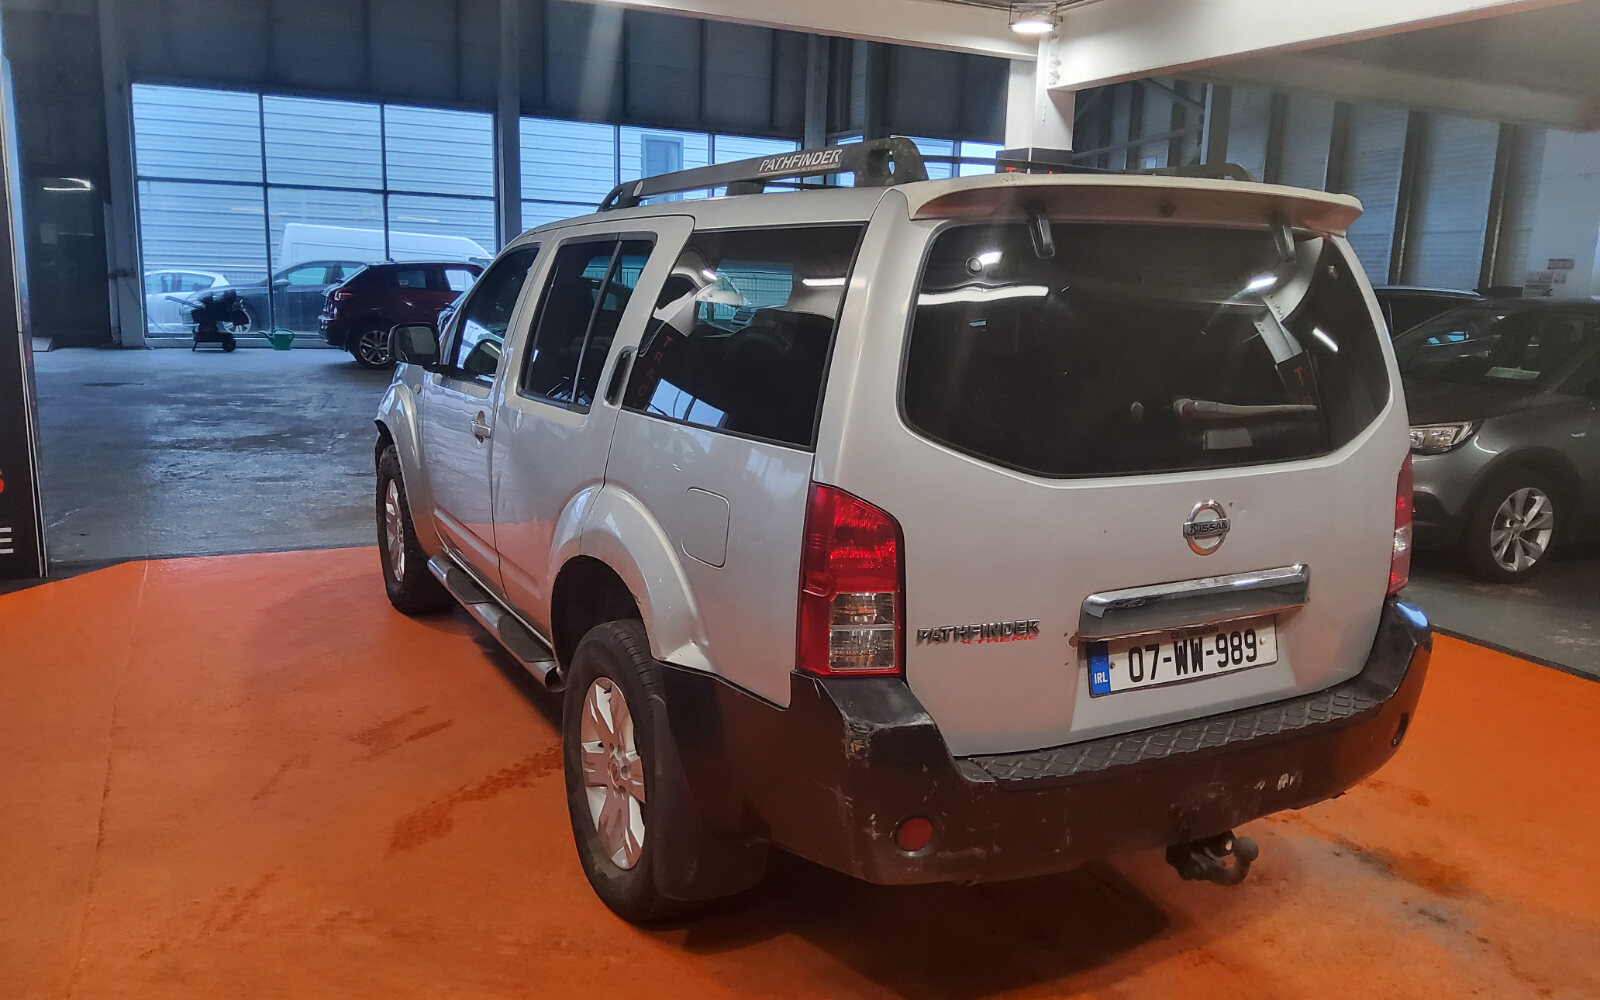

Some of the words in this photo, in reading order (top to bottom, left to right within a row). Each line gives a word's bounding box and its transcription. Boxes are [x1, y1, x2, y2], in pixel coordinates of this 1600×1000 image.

[758, 149, 843, 172] PATHFINDER
[1189, 521, 1228, 533] NISSAN
[916, 619, 1040, 645] PATHFINDER
[1128, 629, 1257, 683] 07-WW-989
[1094, 672, 1108, 685] IRL
